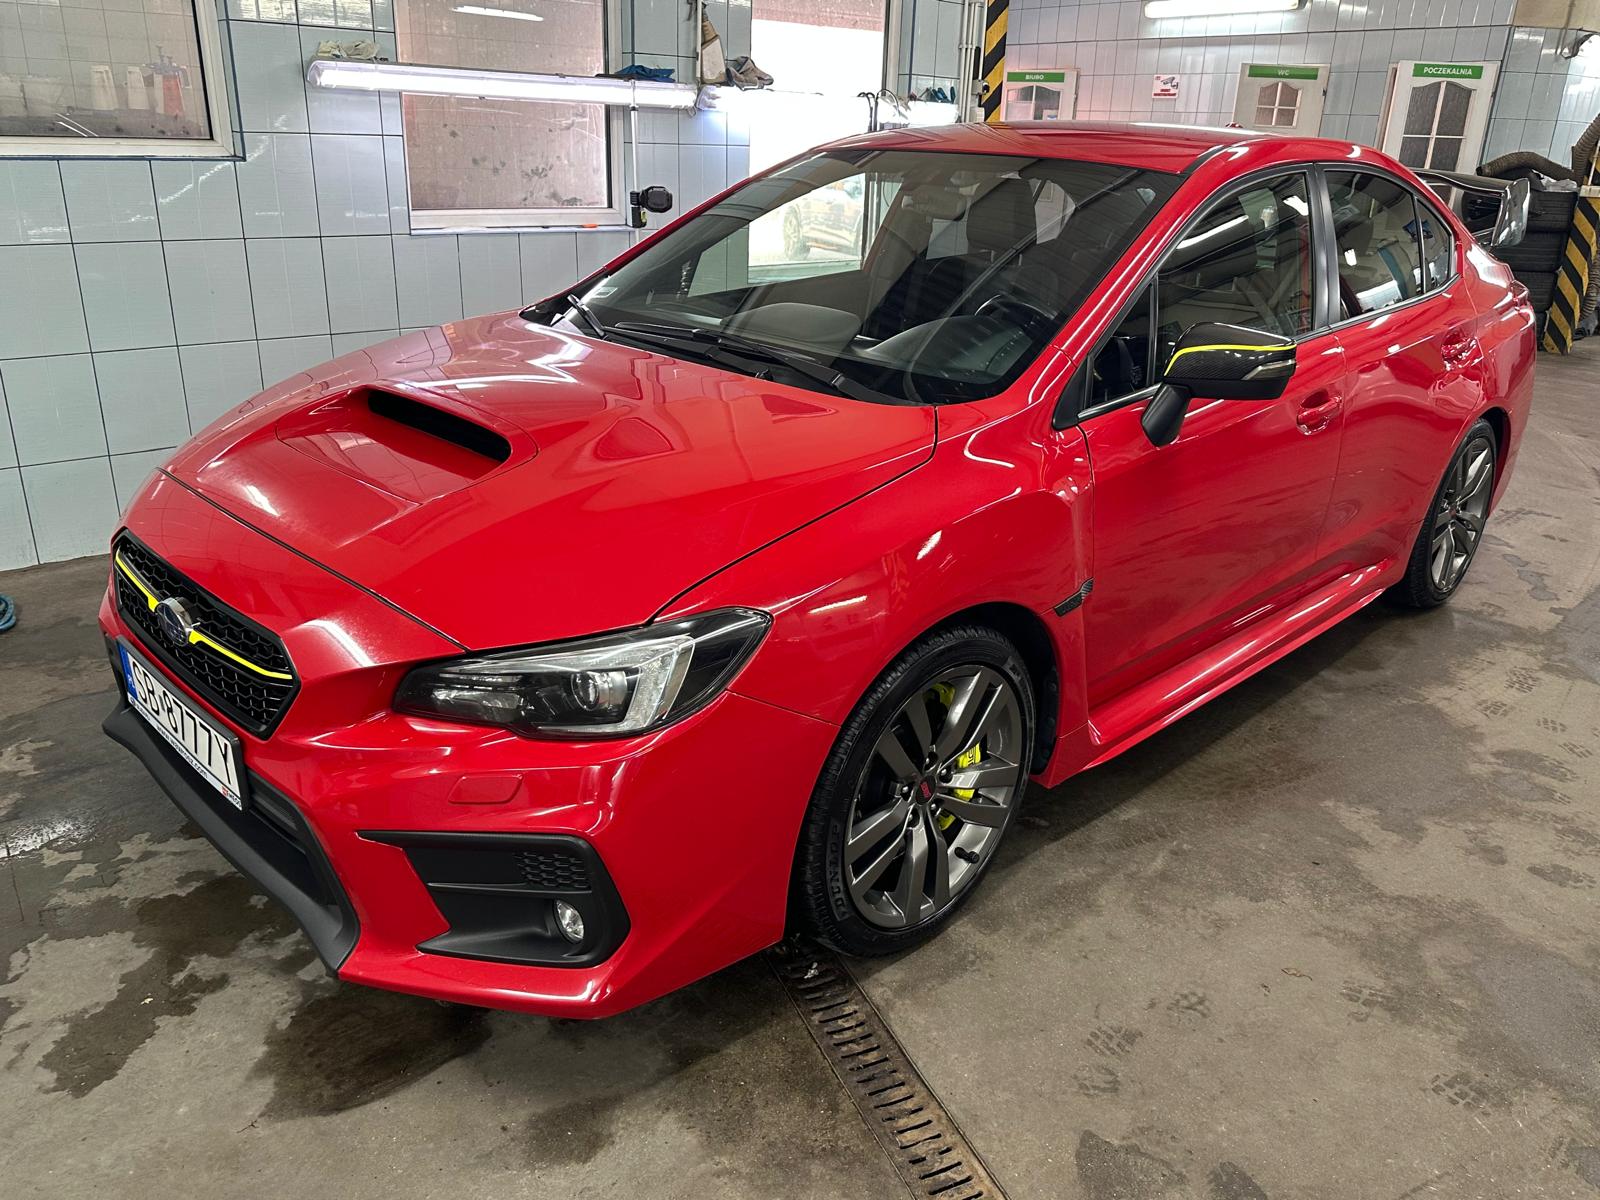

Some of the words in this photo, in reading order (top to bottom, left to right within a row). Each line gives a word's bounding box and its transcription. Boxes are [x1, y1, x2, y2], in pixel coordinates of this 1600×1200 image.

[1423, 66, 1472, 75] POCZEKALNIA
[132, 660, 160, 716] SB
[162, 689, 232, 786] 8777Y
